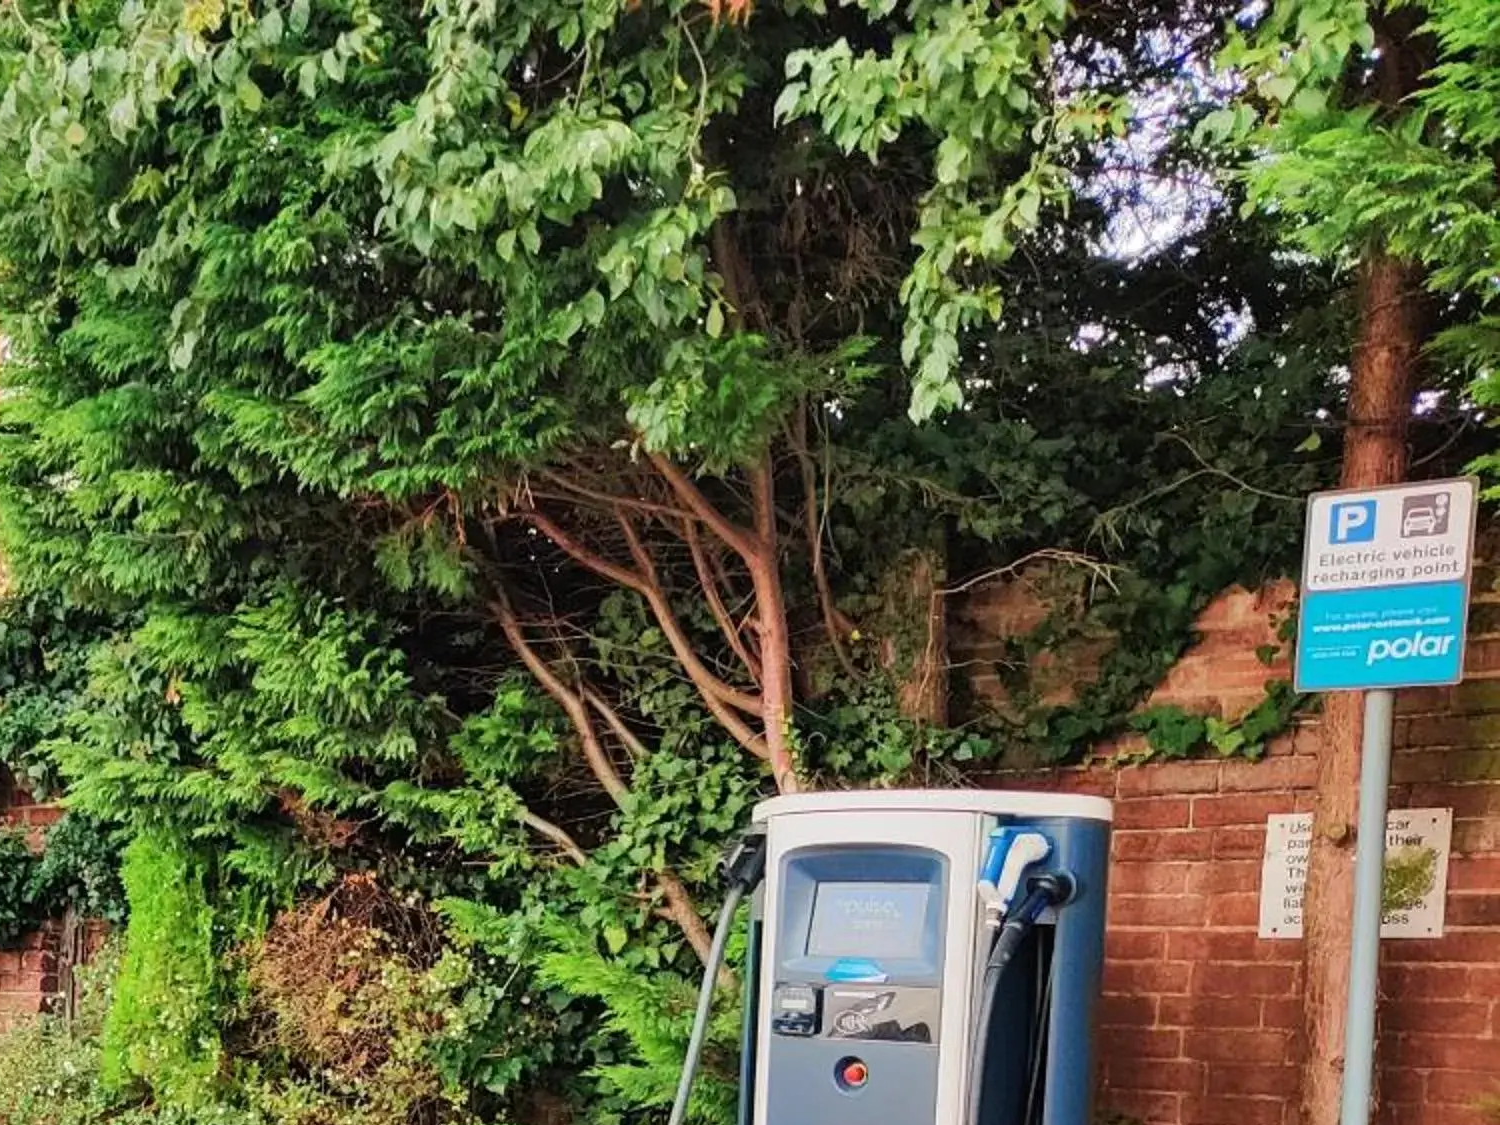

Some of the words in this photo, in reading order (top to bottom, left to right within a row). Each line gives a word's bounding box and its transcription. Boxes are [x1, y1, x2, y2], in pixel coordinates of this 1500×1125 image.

[1337, 505, 1368, 541] P
[1318, 549, 1387, 567] Electric
[1392, 543, 1456, 561] vehicle
[1312, 566, 1406, 585] recharging
[1412, 561, 1460, 580] point
[1366, 630, 1455, 667] polar
[1389, 834, 1424, 846] their
